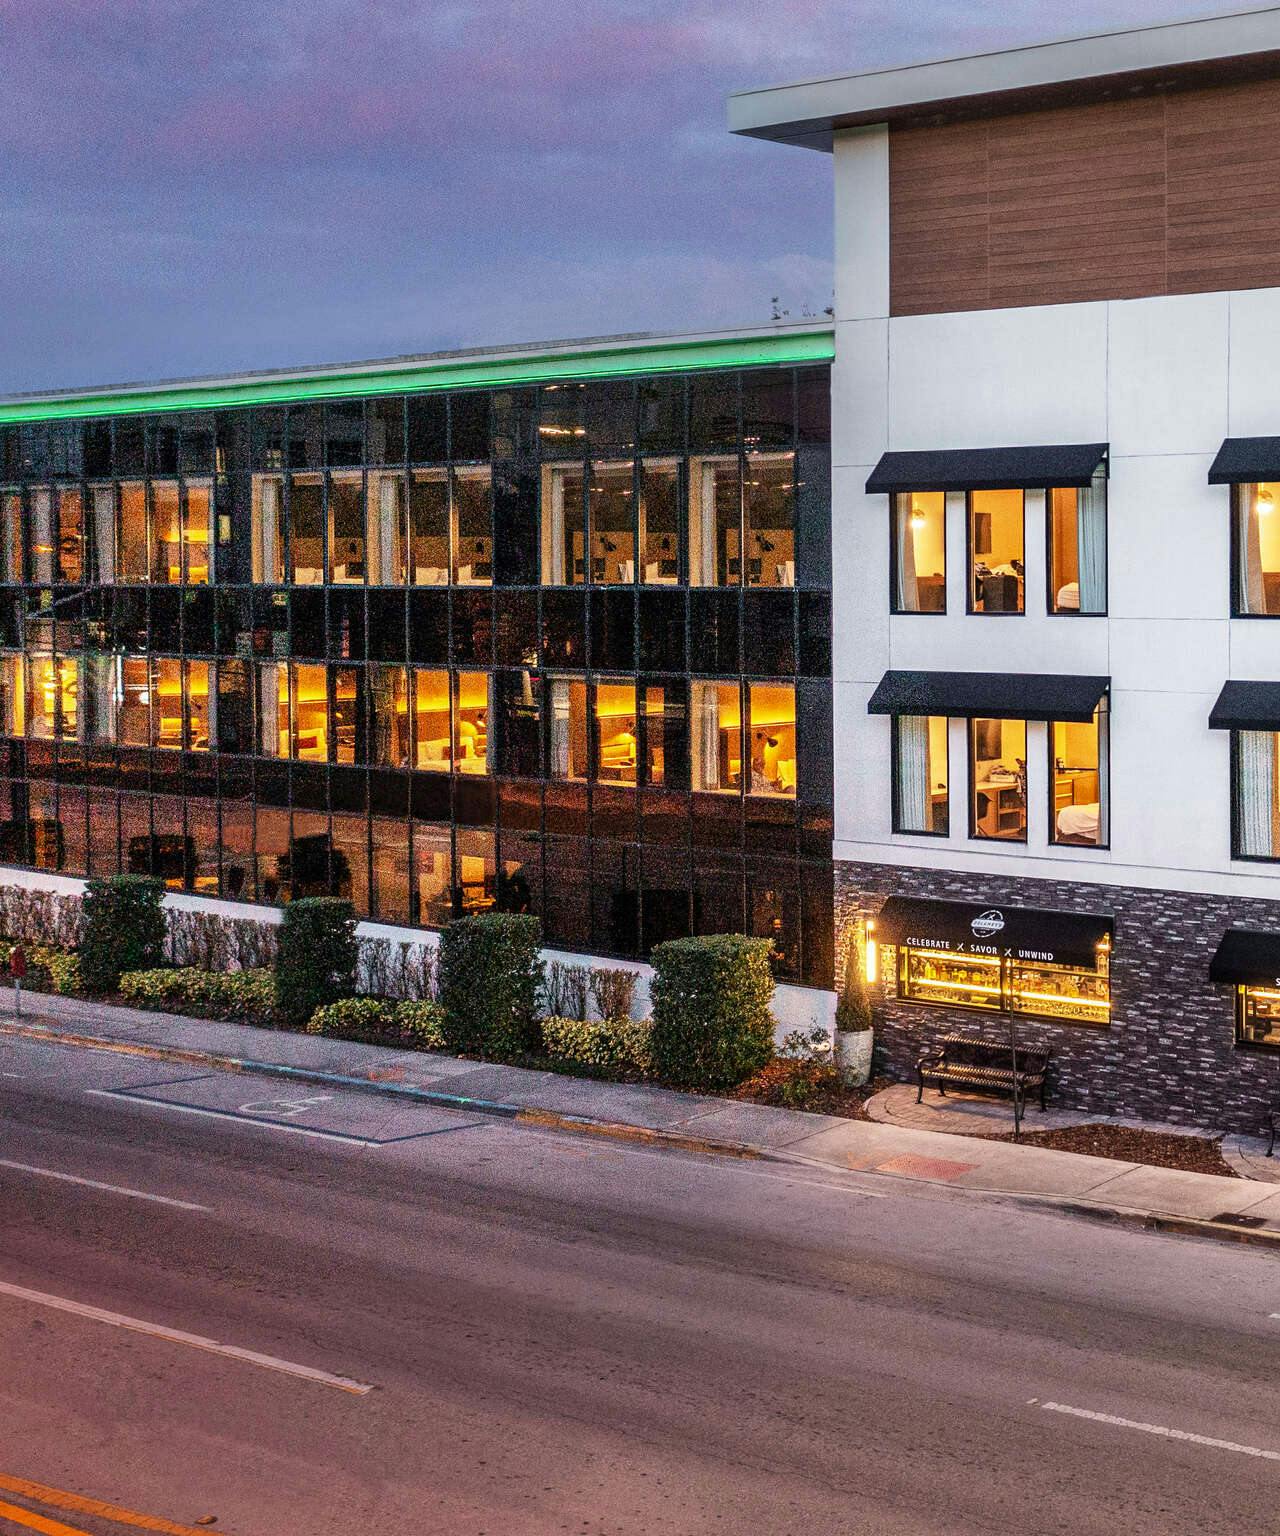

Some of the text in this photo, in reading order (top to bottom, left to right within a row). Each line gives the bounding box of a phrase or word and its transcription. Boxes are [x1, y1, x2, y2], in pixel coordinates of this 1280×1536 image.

[906, 936, 1054, 961] CELEBRATE SAVOR UNWIND
